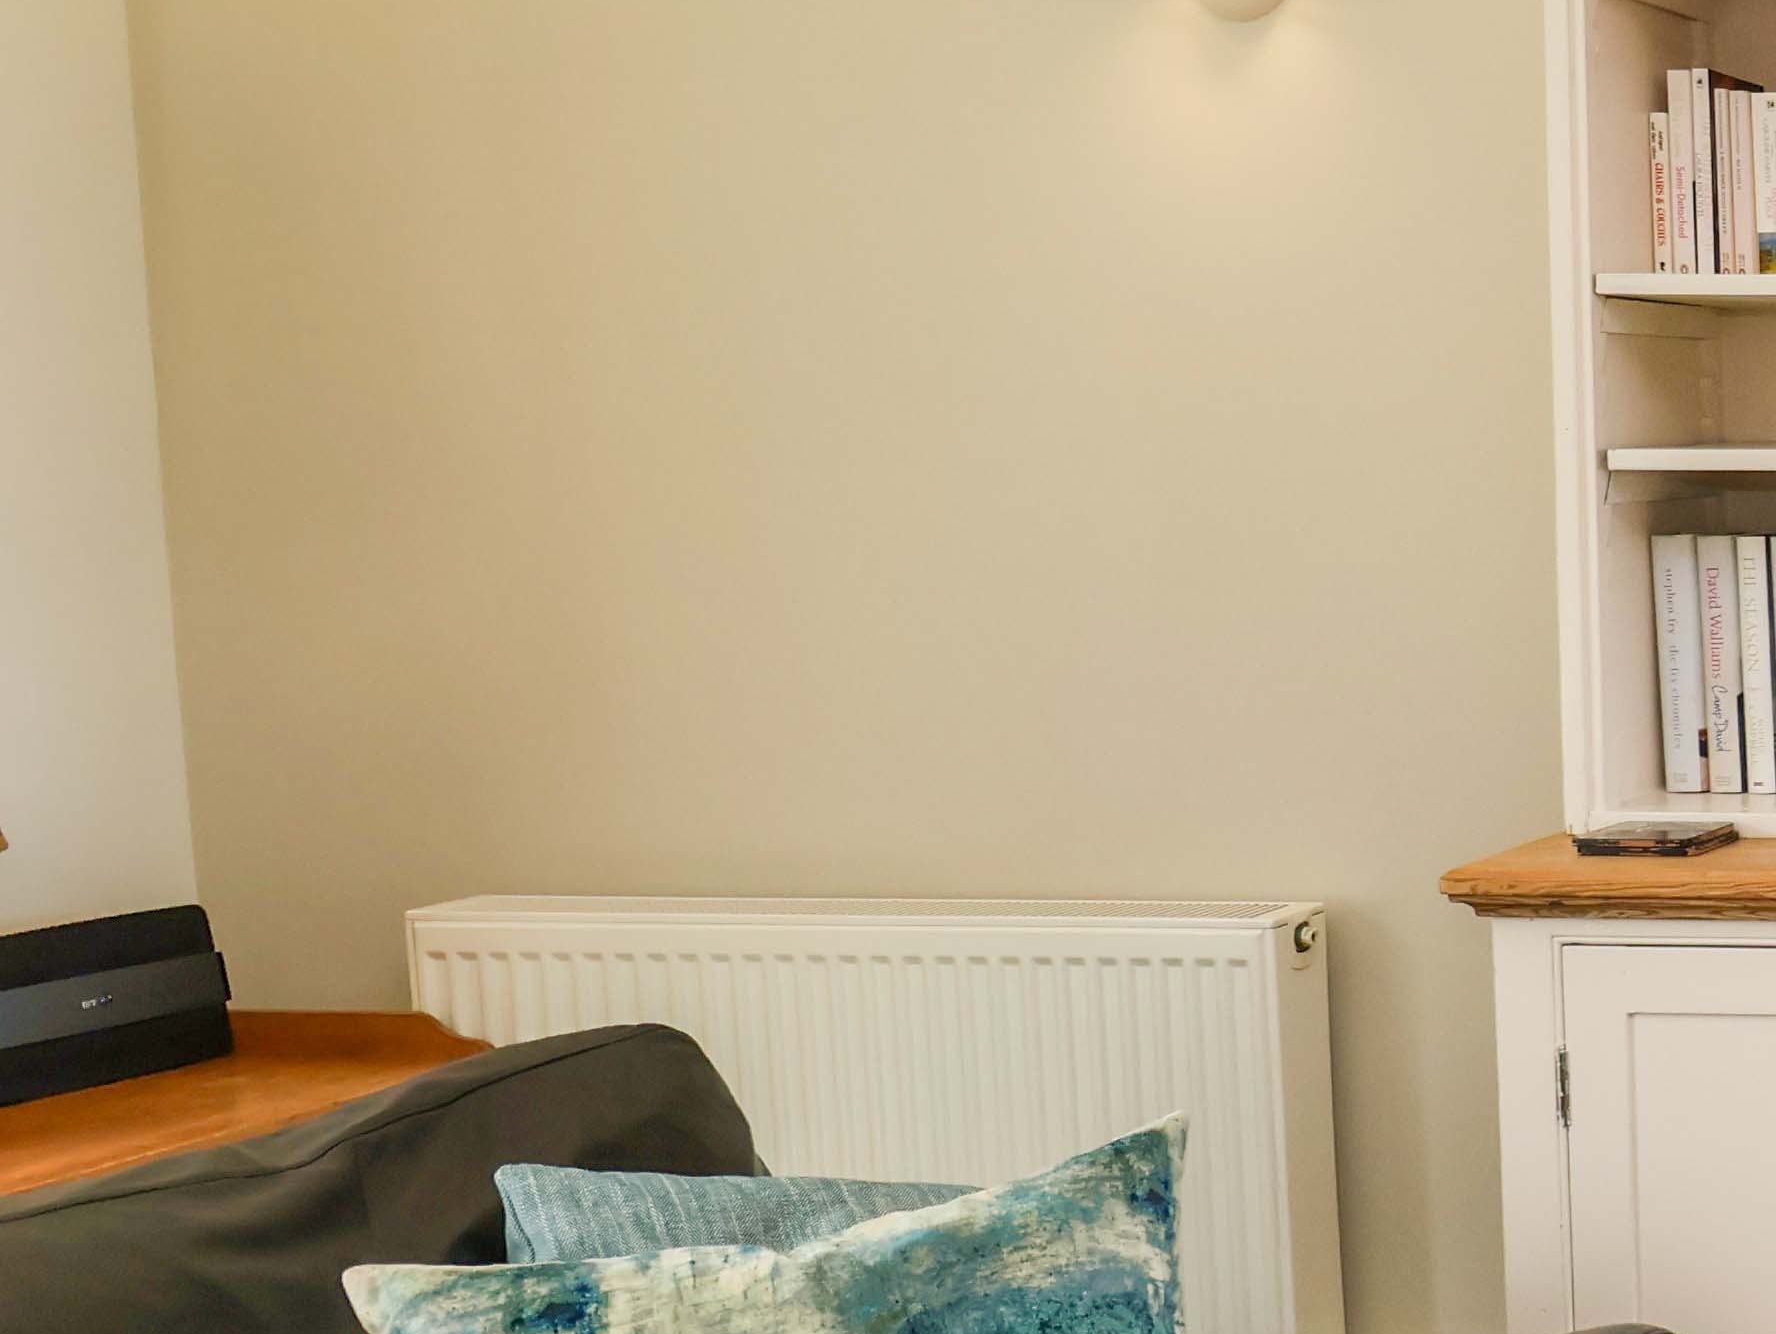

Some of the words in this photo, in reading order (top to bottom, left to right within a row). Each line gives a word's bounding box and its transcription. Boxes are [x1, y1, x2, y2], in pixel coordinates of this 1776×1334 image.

[1653, 162, 1666, 195] CHAIRS
[1705, 567, 1722, 609] David
[1709, 614, 1725, 678] Walliams
